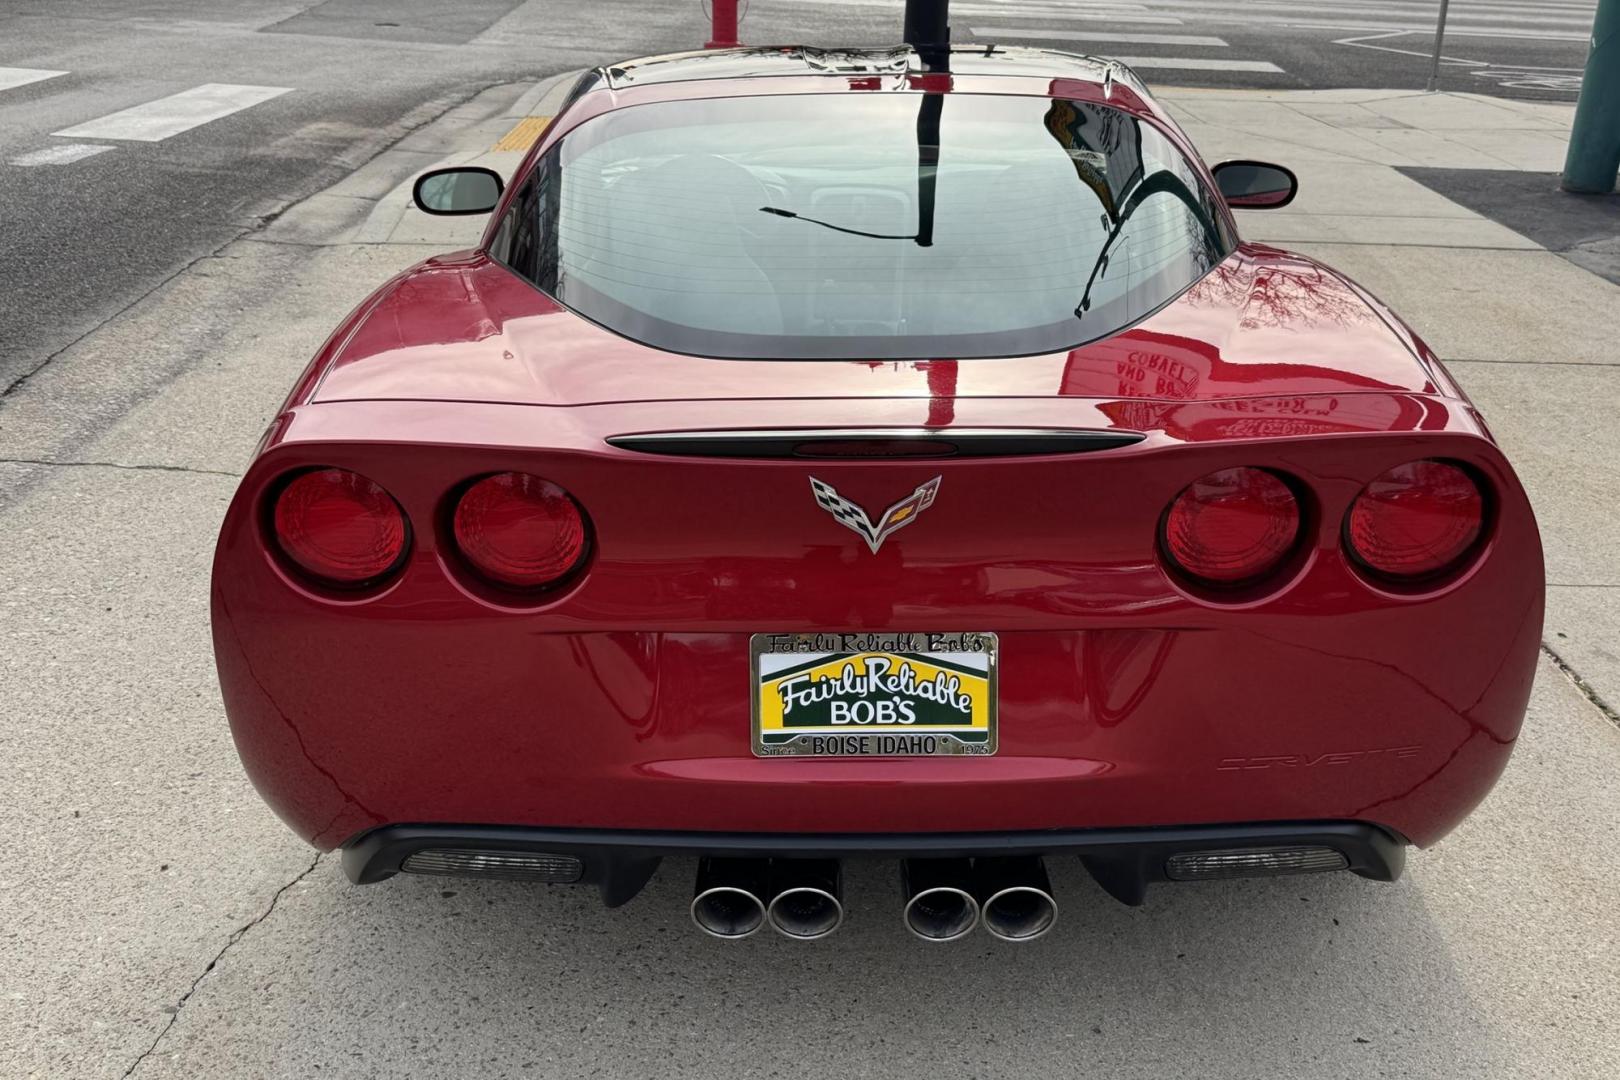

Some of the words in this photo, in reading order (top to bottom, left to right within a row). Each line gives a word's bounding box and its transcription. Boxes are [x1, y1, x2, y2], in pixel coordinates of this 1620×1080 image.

[766, 633, 834, 653] Fairly
[838, 633, 920, 652] Reliable
[925, 633, 985, 652] Bob's
[778, 662, 869, 715] Fairly
[864, 656, 972, 714] Reliable
[830, 696, 917, 725] BOB'S
[813, 735, 870, 755] BOISE
[877, 735, 937, 755] IDAHO
